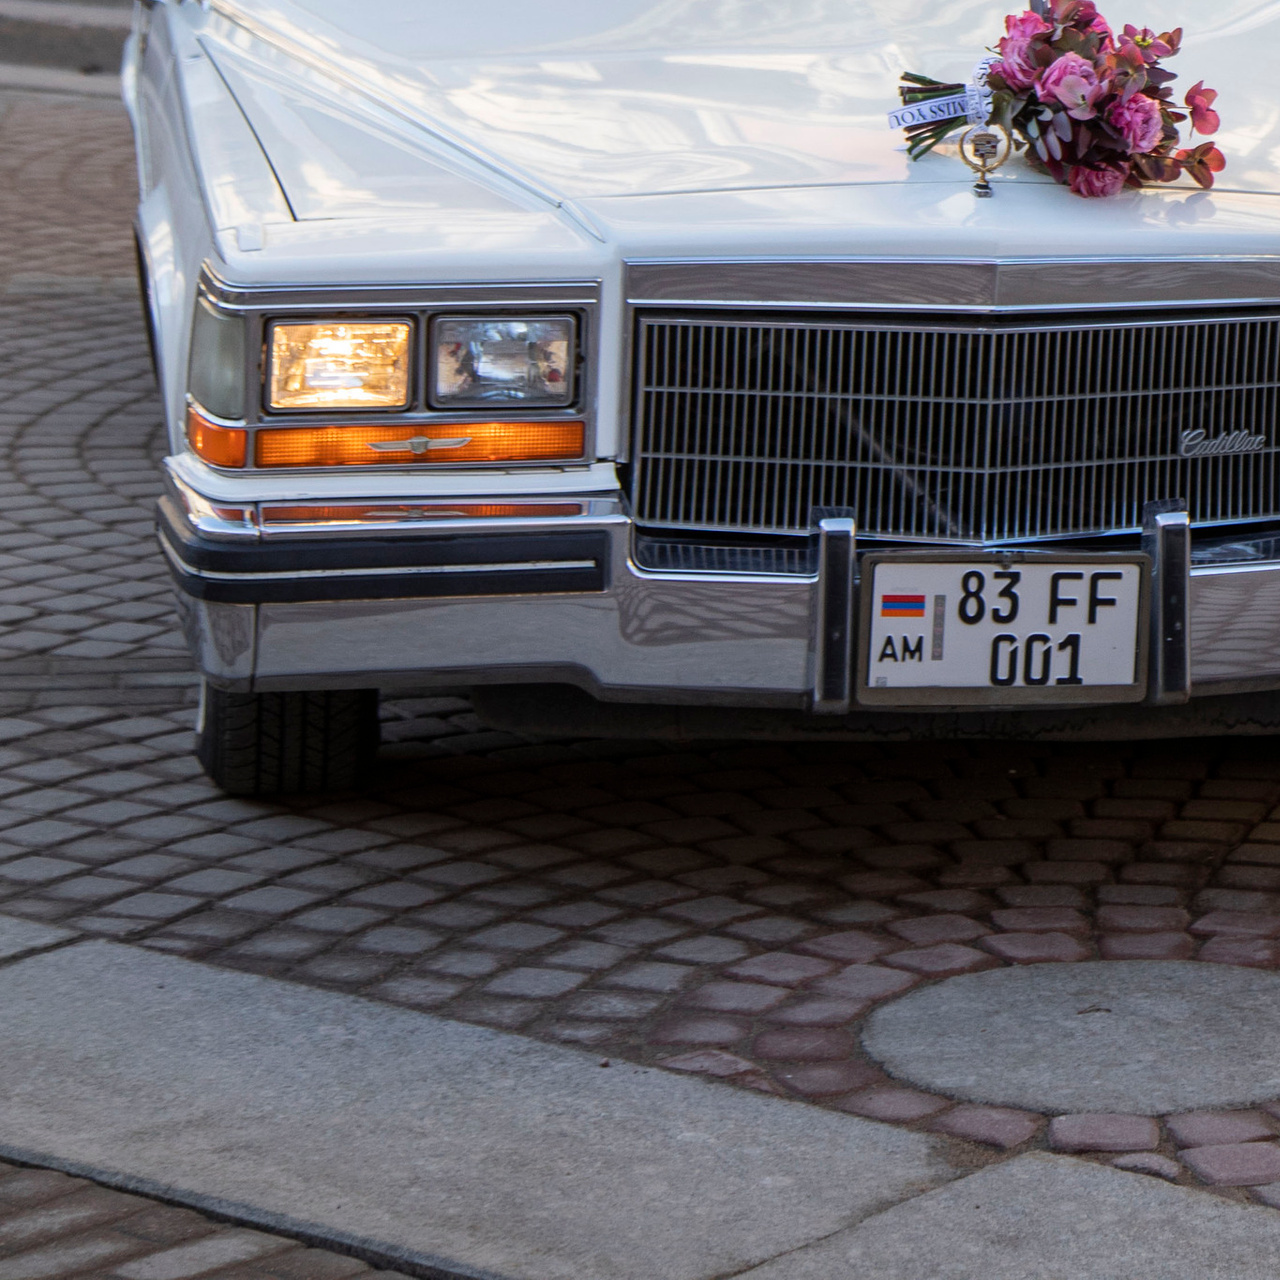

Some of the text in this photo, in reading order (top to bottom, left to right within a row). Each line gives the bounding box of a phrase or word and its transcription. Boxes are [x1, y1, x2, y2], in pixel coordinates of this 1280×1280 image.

[890, 108, 927, 127] YOU
[1181, 428, 1266, 457] Cadillac
[958, 570, 1123, 625] 83 FF
[878, 635, 924, 662] AM
[989, 633, 1083, 686] 001
